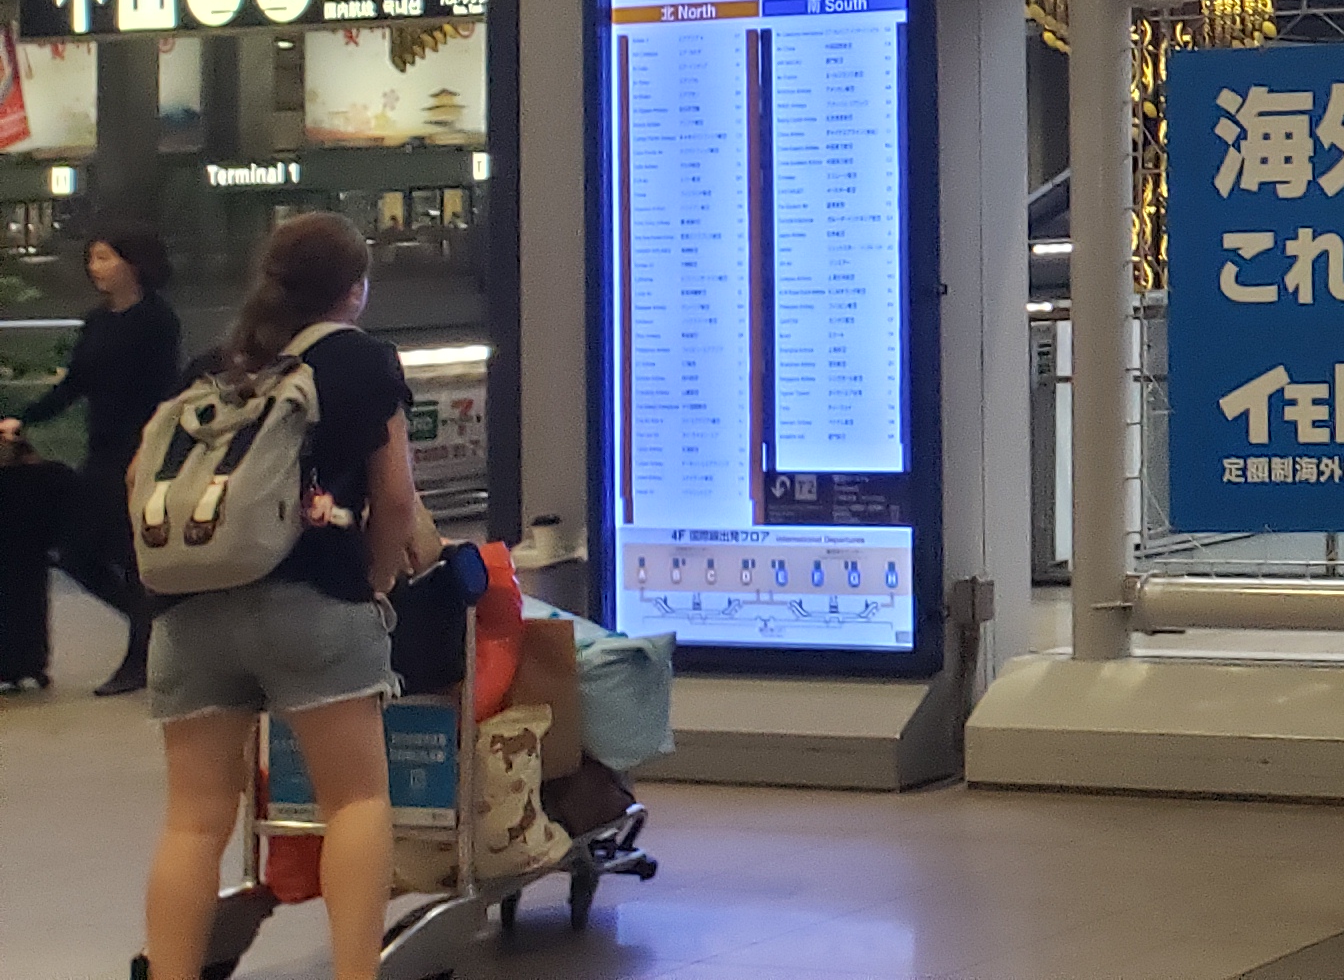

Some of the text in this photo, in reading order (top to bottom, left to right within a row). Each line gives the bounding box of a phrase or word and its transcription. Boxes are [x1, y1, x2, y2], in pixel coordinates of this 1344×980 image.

[678, 4, 716, 19] North
[207, 162, 301, 186] Terminal 1
